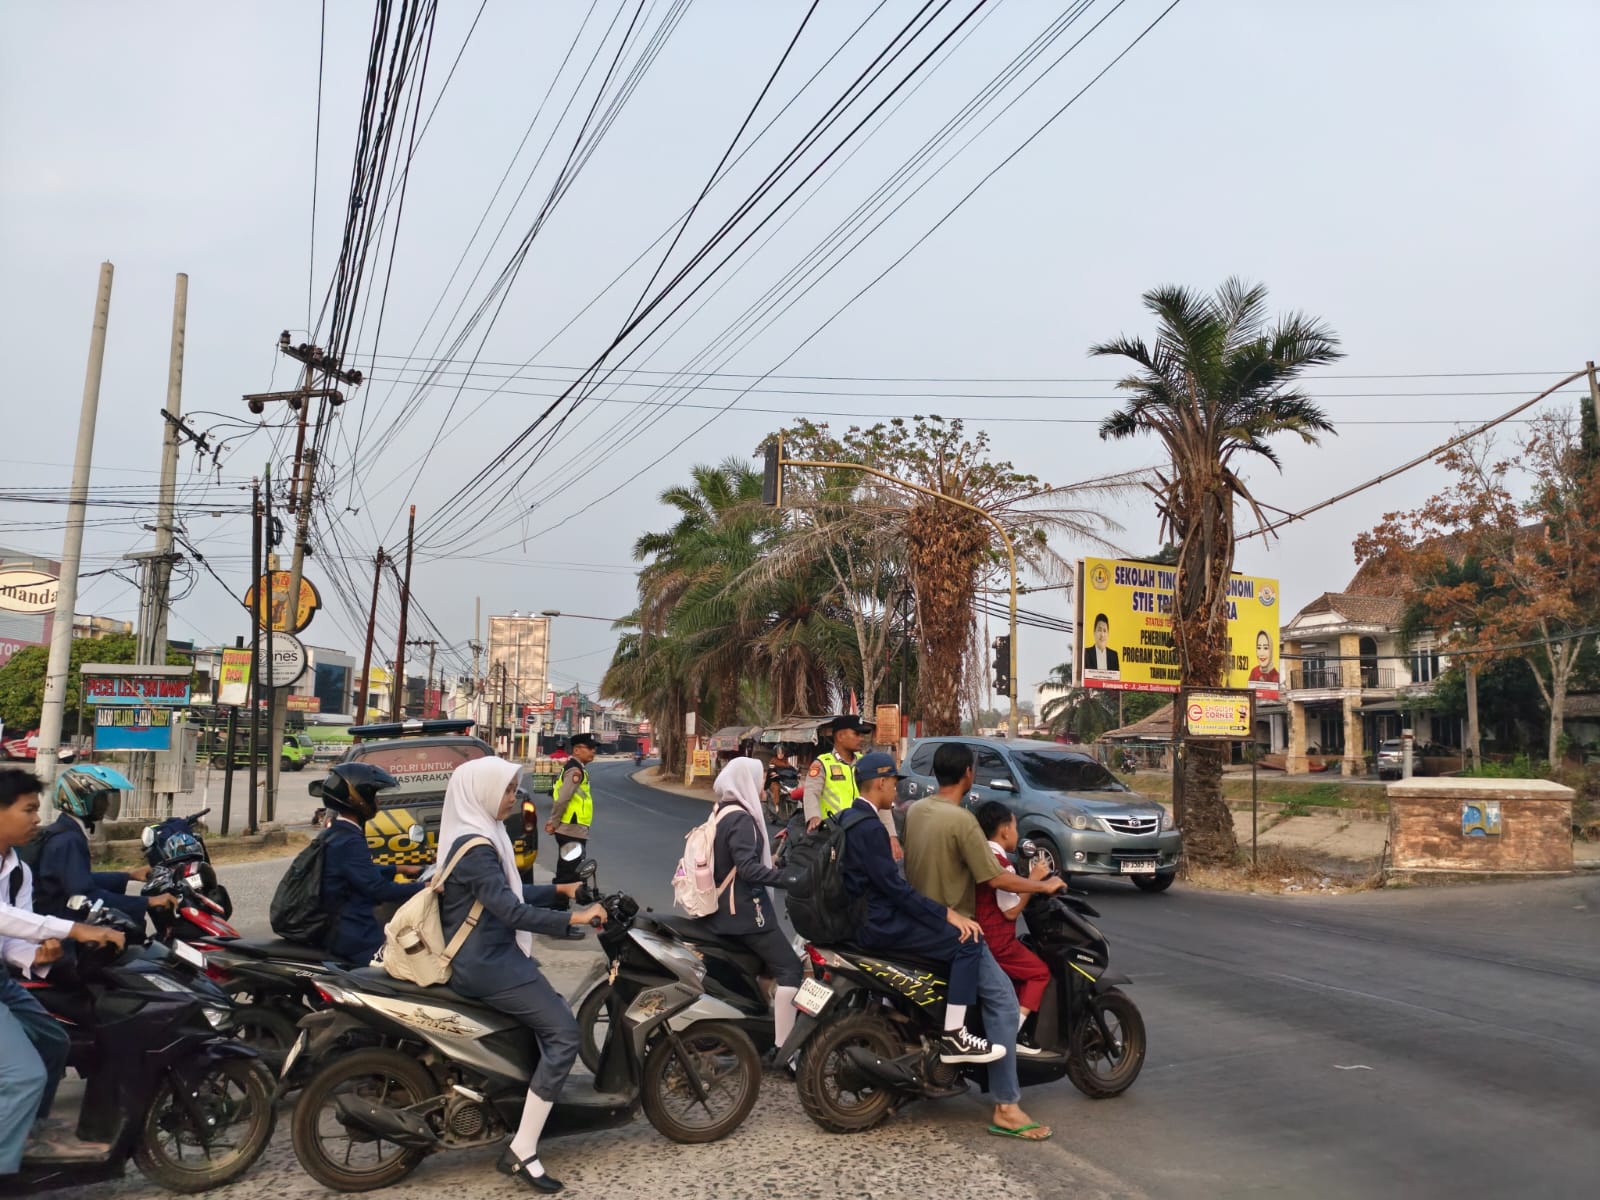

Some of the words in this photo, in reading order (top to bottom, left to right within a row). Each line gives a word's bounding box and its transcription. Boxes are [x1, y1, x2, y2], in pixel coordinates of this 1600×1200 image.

[1115, 566, 1155, 587] SEKOLAH
[1132, 591, 1154, 612] STIE
[1122, 647, 1153, 664] PROGRAM
[87, 679, 117, 697] PECEL
[390, 764, 419, 773] POLRI
[421, 761, 453, 771] UNTUK
